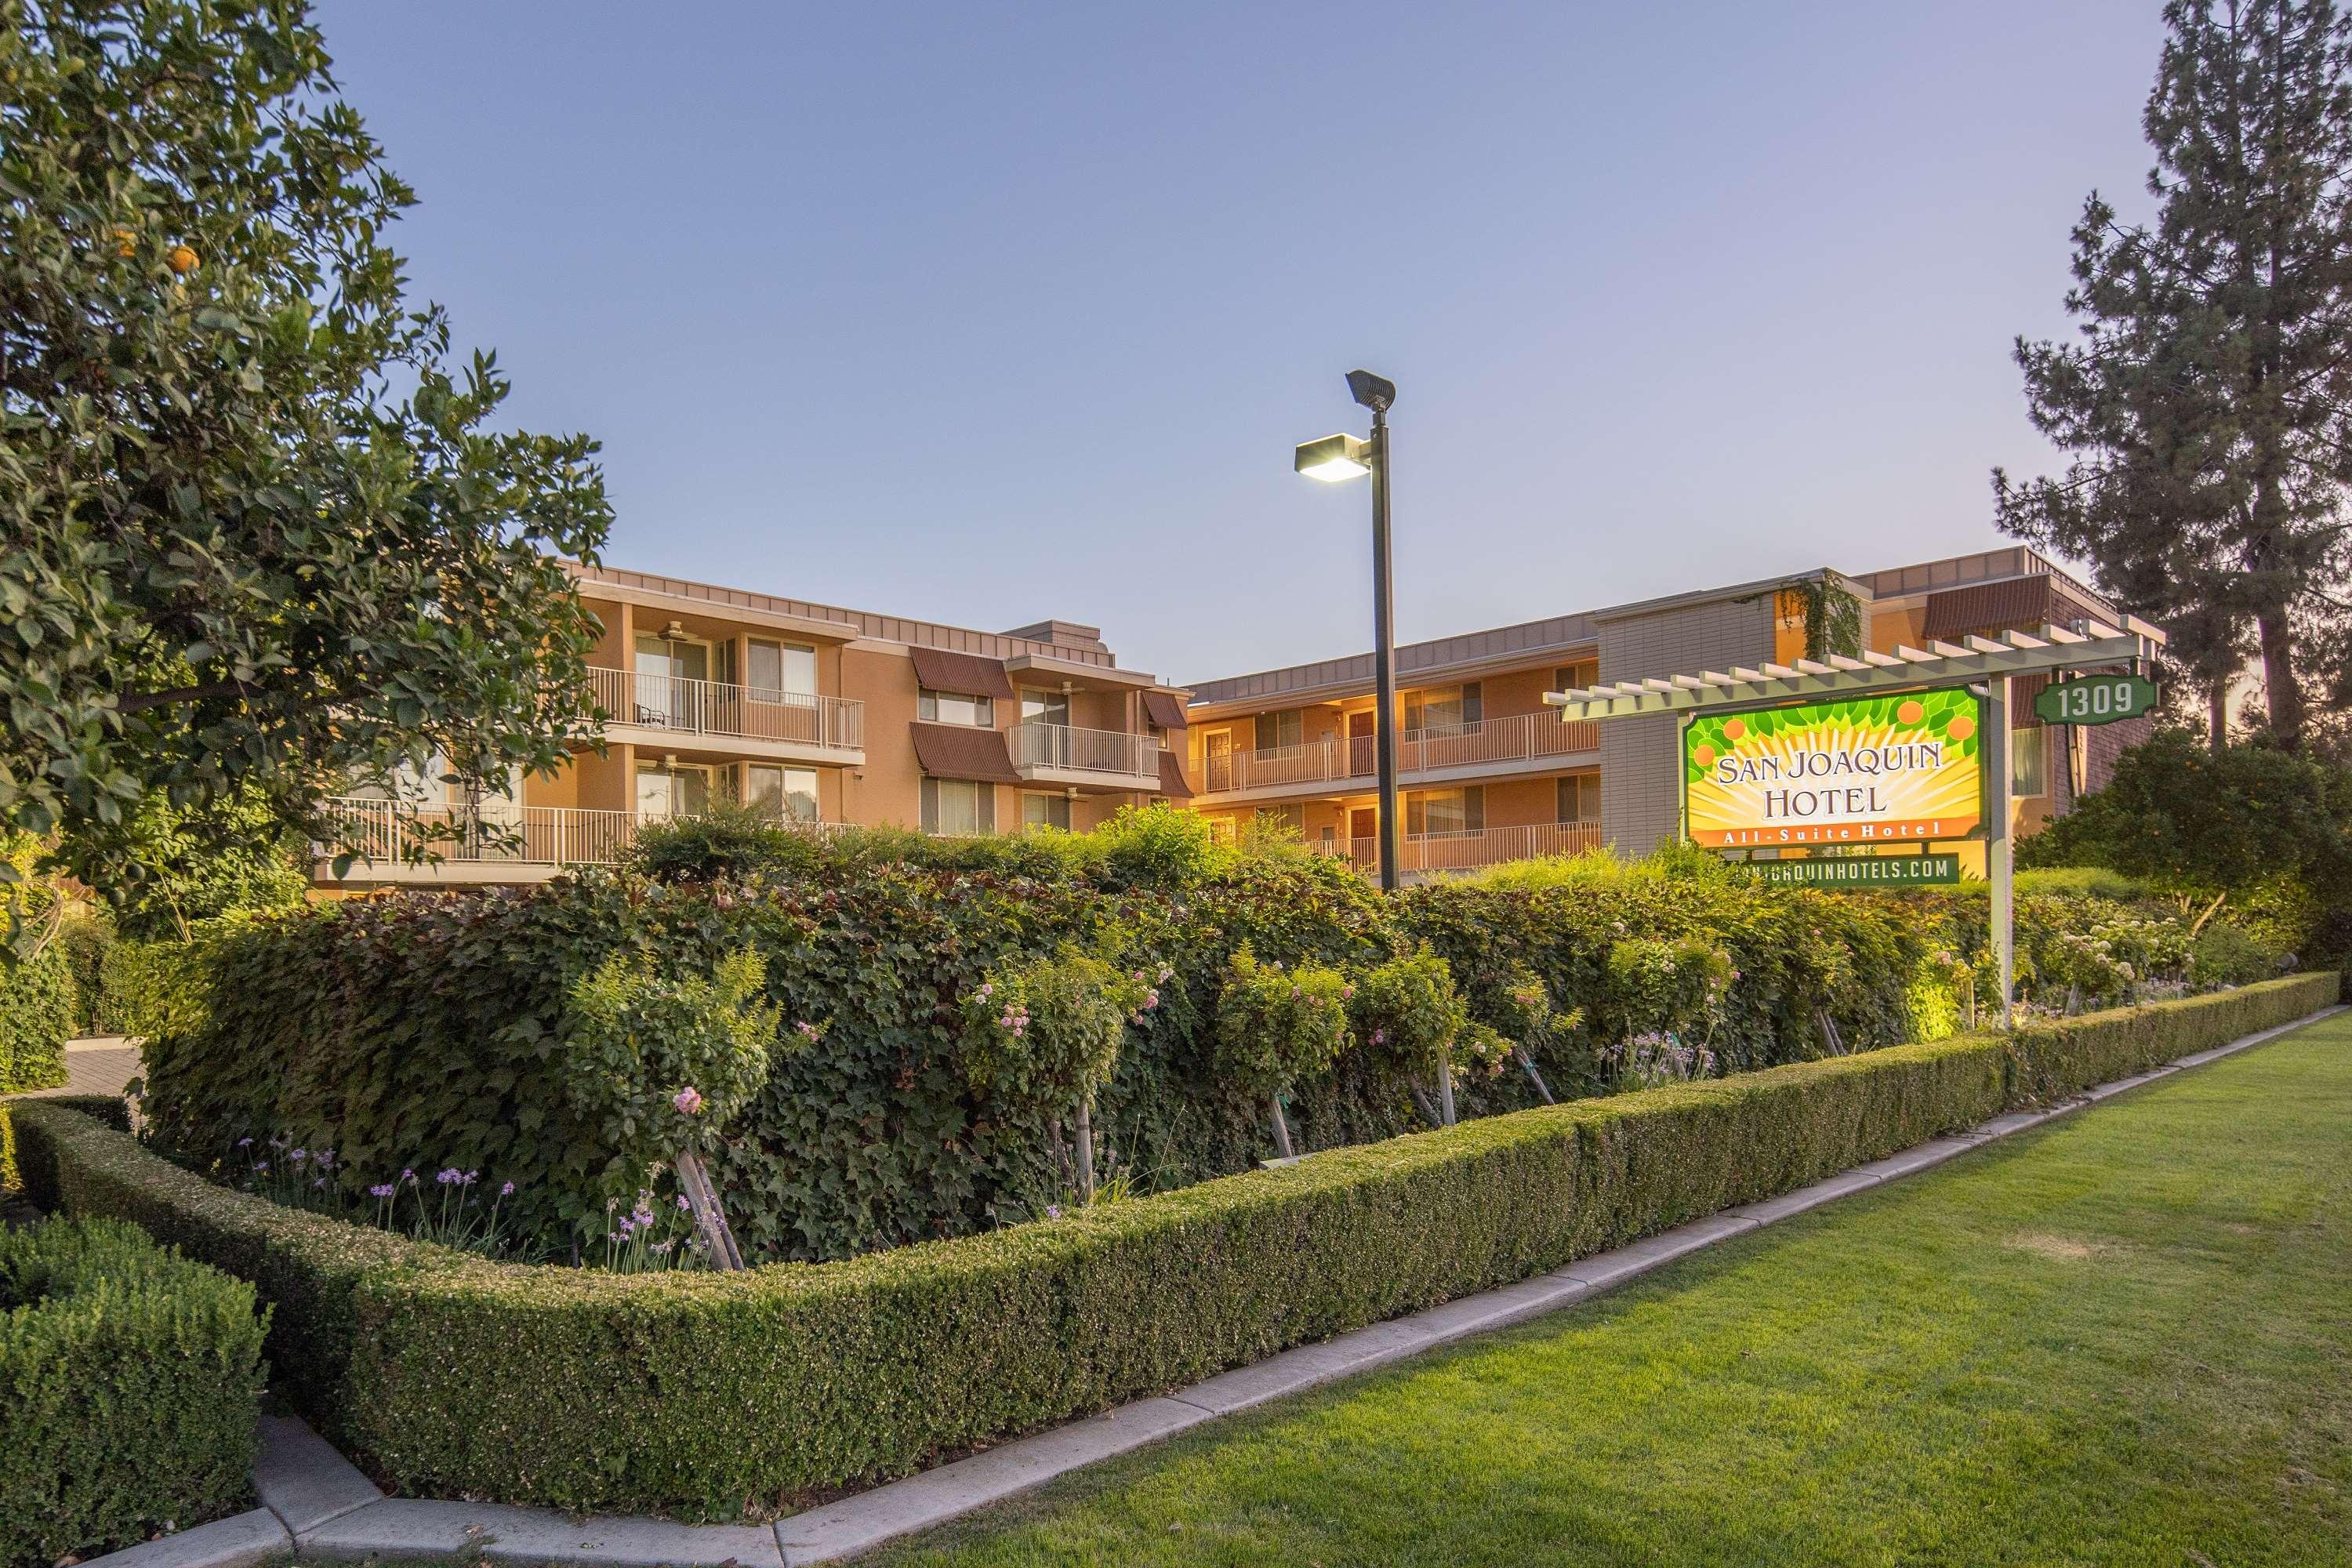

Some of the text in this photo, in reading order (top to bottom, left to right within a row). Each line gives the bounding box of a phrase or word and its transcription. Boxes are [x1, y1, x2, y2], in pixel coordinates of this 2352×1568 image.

[2057, 682, 2132, 717] 1309
[1719, 743, 1940, 784] SAN JOAQUIN
[1764, 787, 1888, 818] HOTEL
[1723, 821, 1940, 844] All-Suite Hotel
